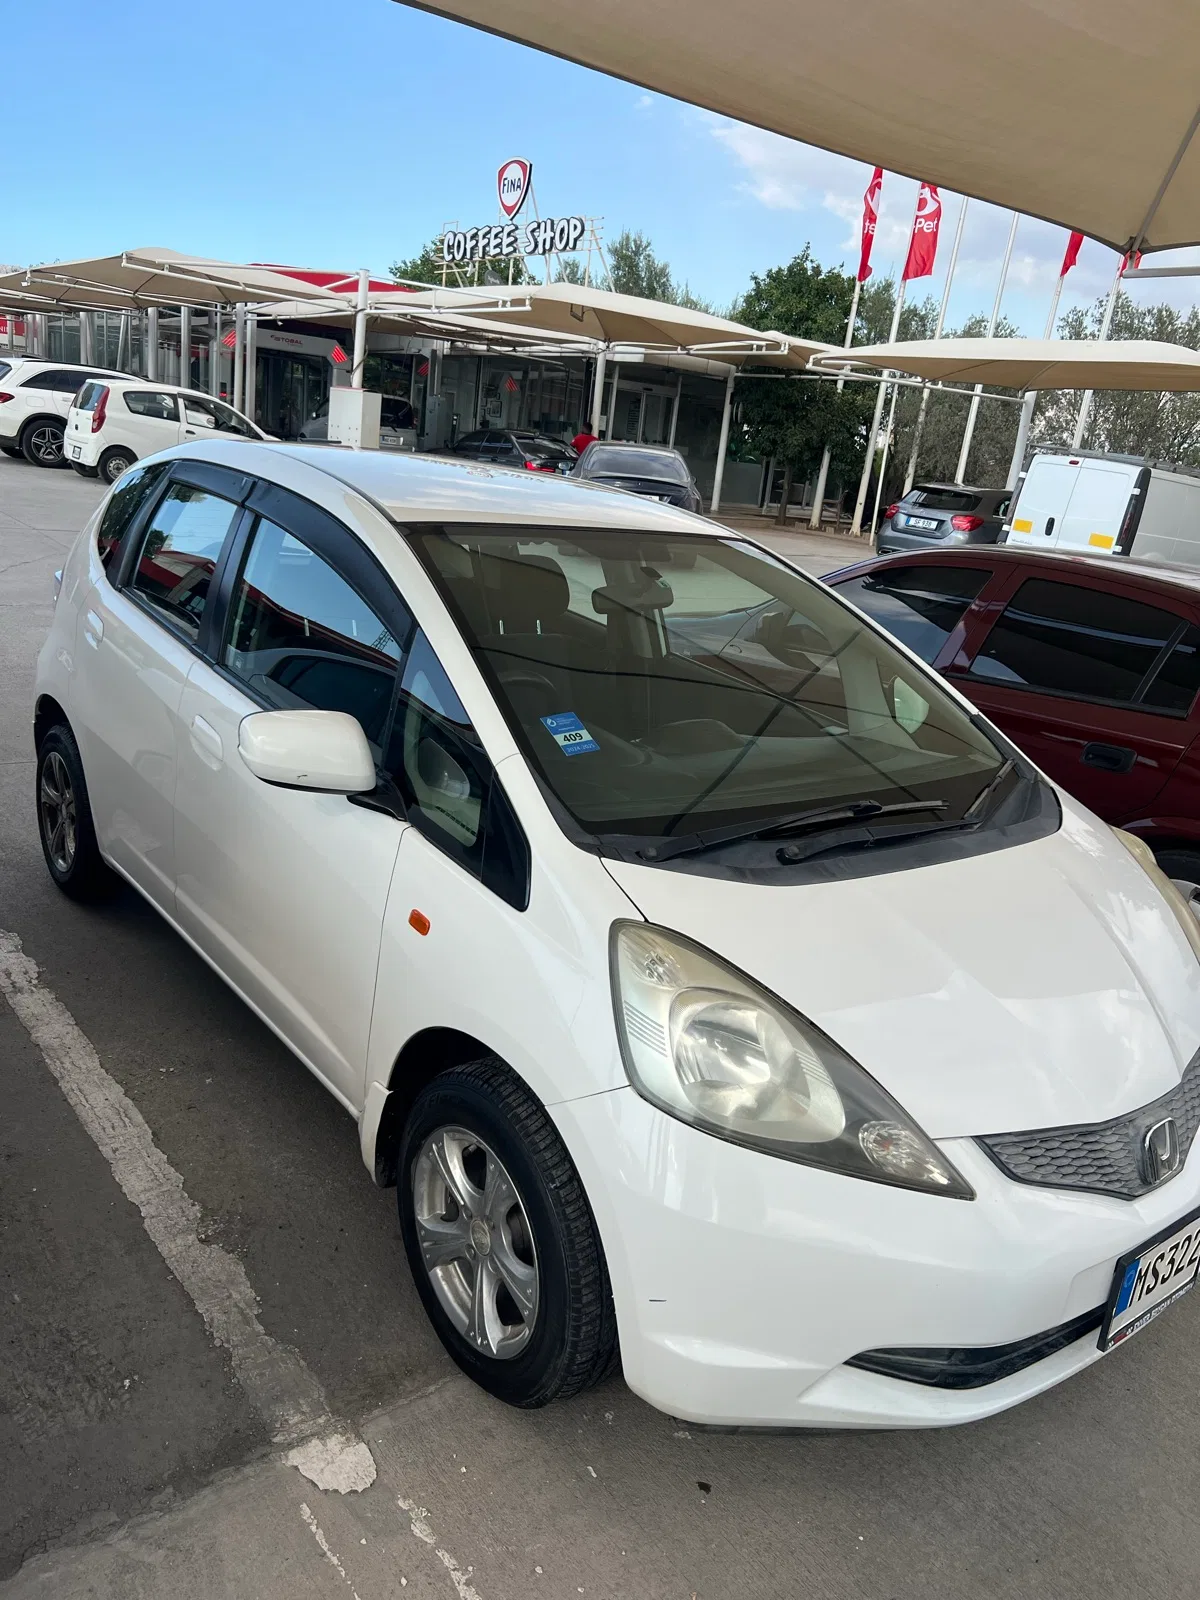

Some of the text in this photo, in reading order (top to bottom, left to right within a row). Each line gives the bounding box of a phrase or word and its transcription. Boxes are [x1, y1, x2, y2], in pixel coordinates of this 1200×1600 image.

[501, 177, 522, 194] FINA
[443, 216, 585, 262] COFFEE SHOP
[563, 732, 583, 743] 409
